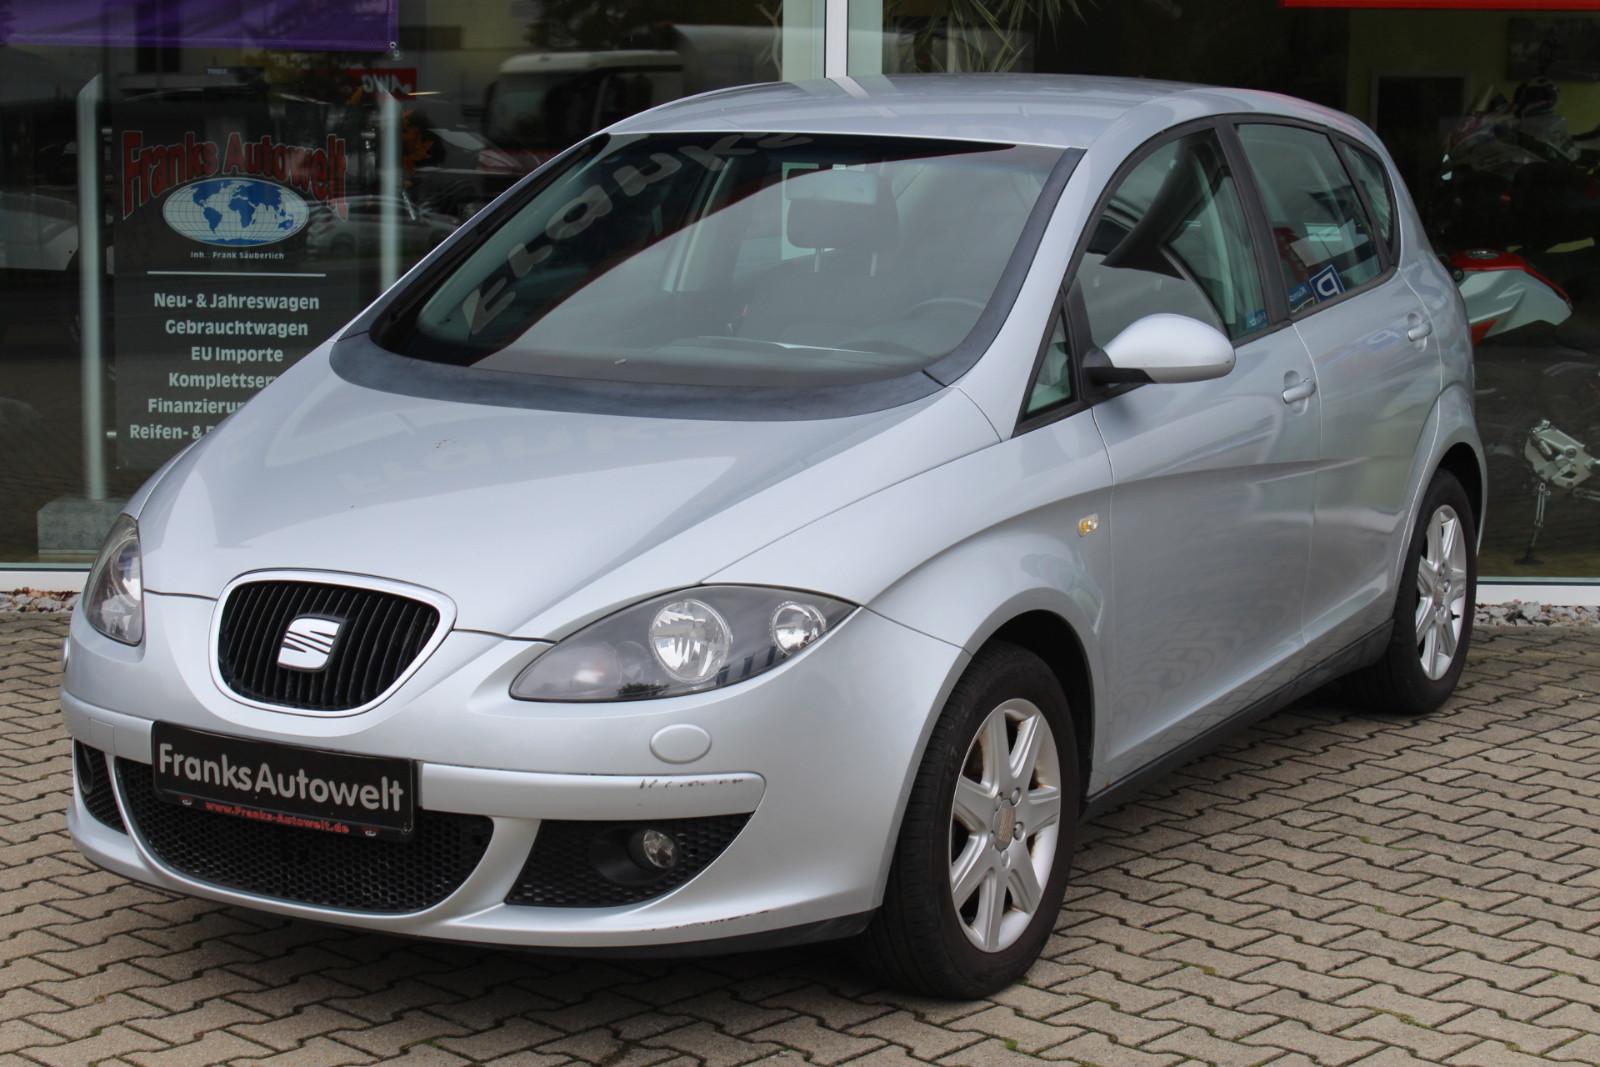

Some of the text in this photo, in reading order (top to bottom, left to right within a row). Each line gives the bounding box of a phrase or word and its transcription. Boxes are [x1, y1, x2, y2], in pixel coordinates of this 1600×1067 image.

[121, 130, 348, 222] Franks Autowelt
[212, 251, 237, 259] Frank
[153, 292, 319, 312] Neu- & Jahreswagen
[165, 319, 308, 338] Gebrauchtwagen
[191, 346, 284, 364] EU Importe
[168, 372, 277, 391] Komplettser
[129, 424, 190, 441] Reifen-
[192, 425, 203, 440] &
[159, 742, 404, 812] FranksAutowelt
